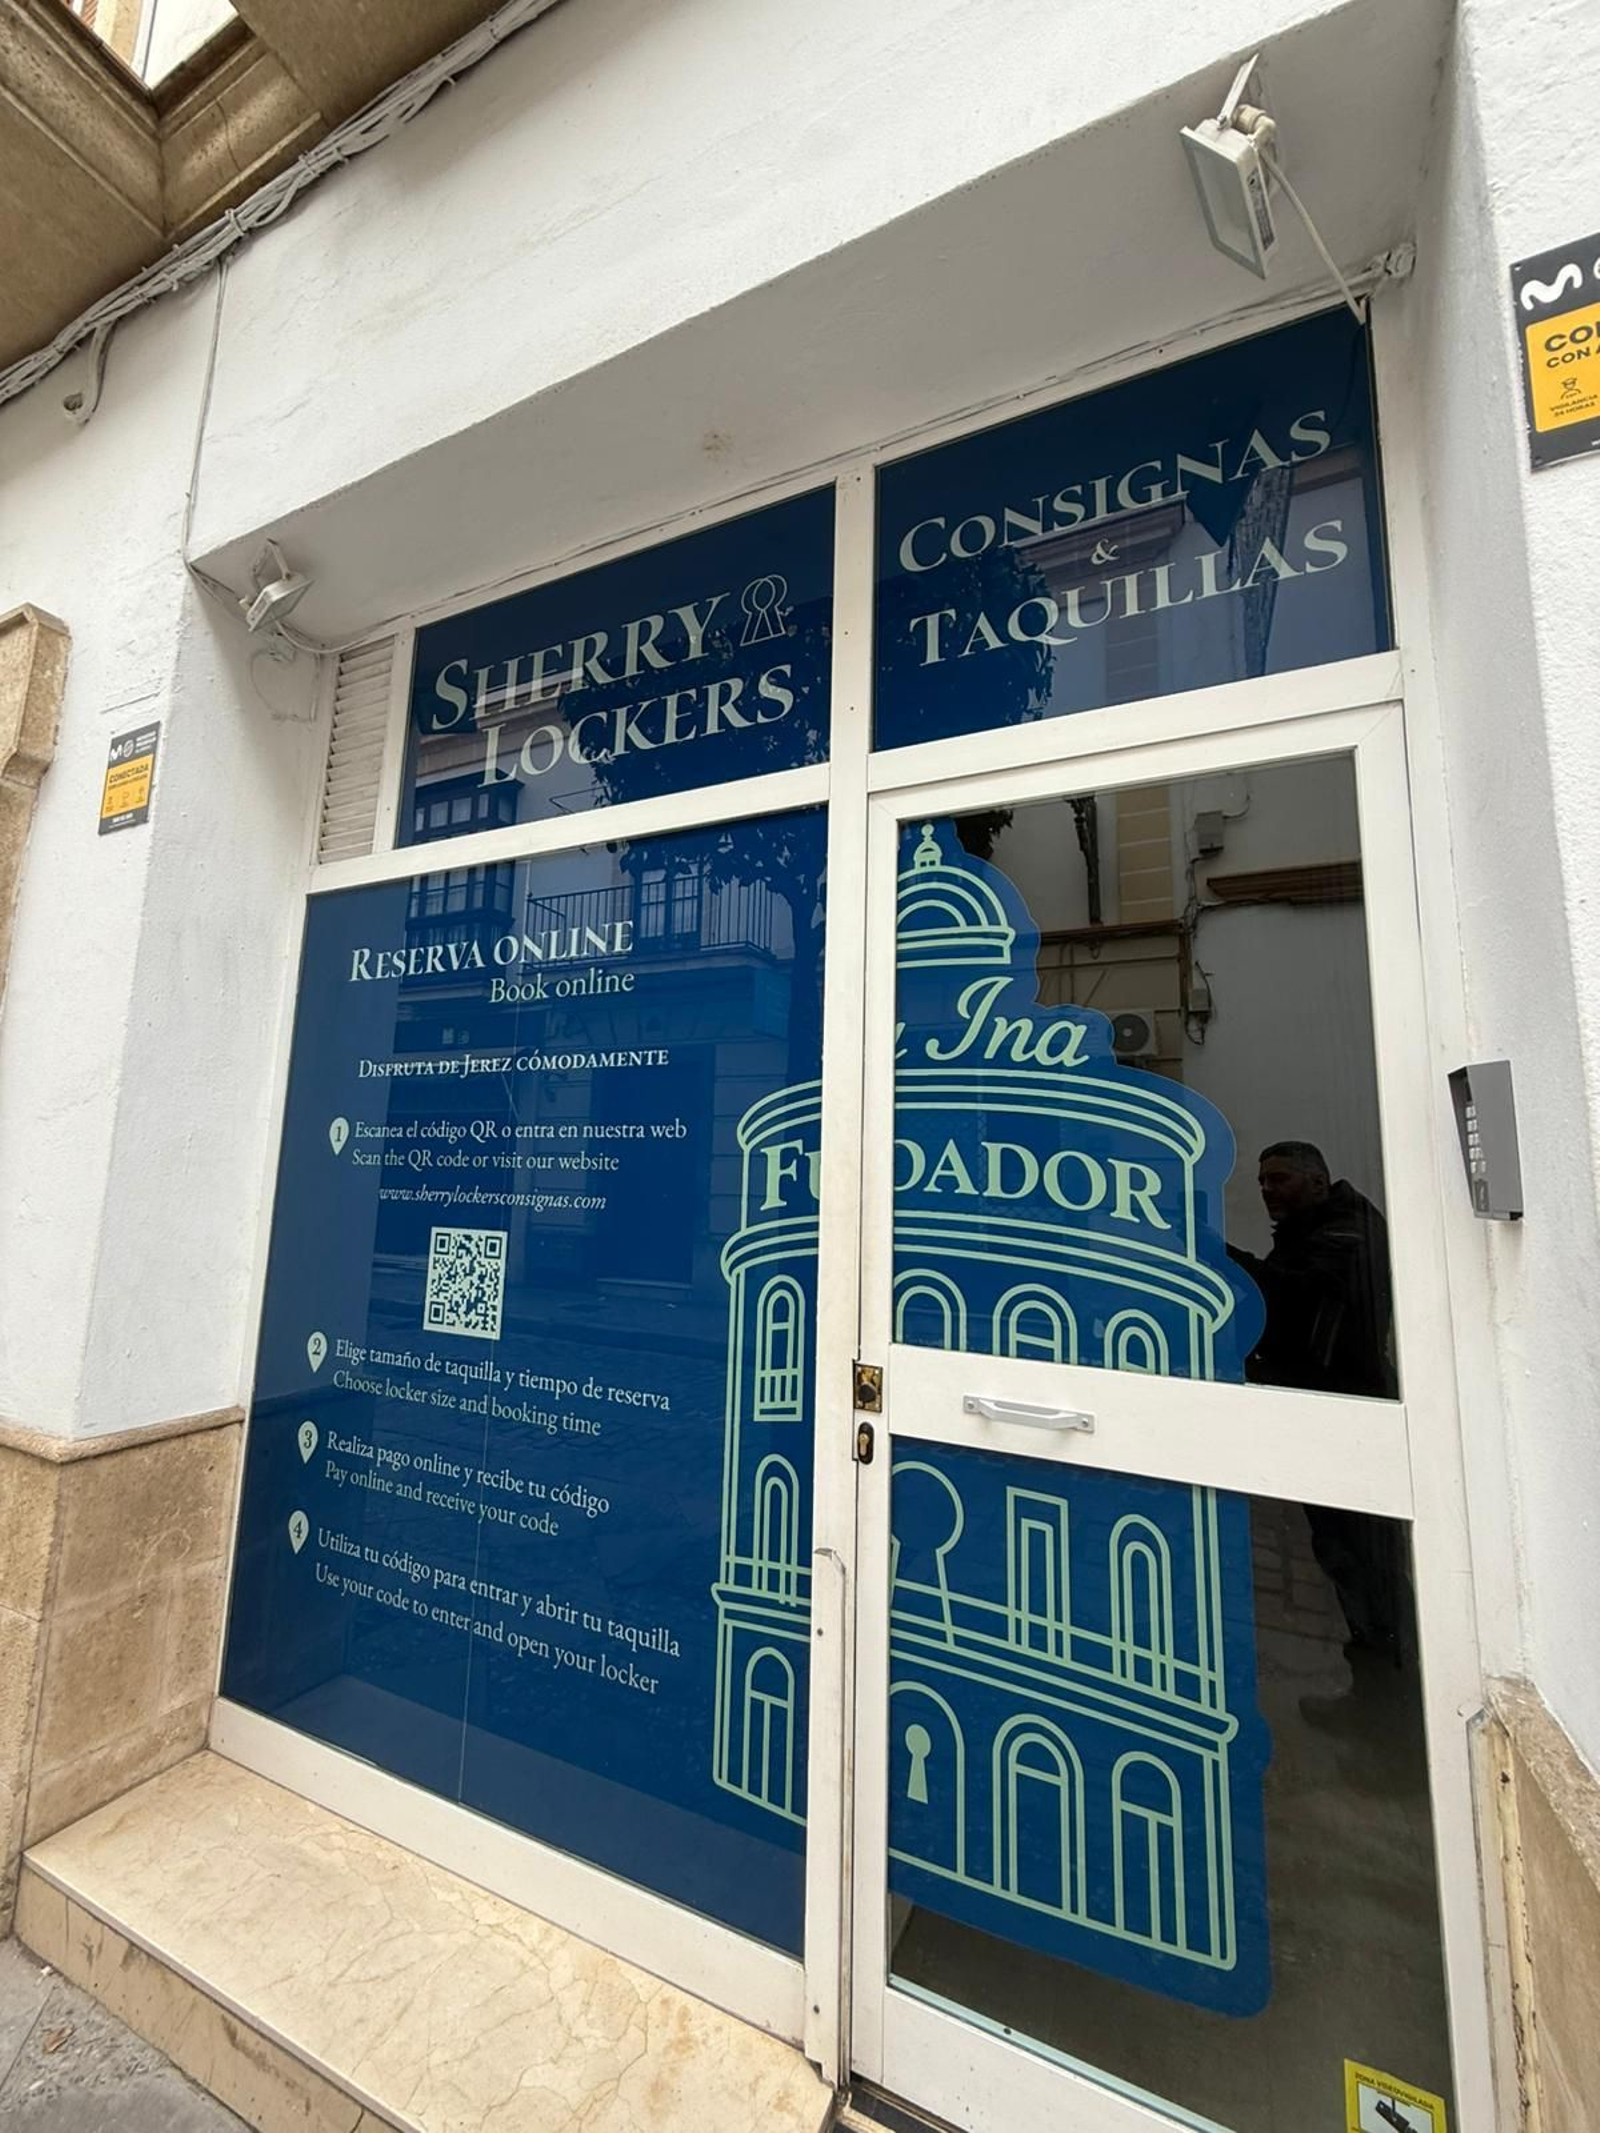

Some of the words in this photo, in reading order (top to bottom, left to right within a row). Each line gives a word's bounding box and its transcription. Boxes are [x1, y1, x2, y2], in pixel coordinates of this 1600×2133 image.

[1545, 321, 1600, 352] CO
[1547, 346, 1591, 368] CON
[899, 410, 1331, 572] CONSIGNAS
[1090, 538, 1119, 566] &
[909, 520, 1349, 667] TAQUILLAS
[431, 591, 730, 731] SHERRY
[477, 663, 794, 788] LOCKERS
[349, 939, 485, 981] RESERVA
[493, 920, 634, 965] ONLINE
[489, 978, 548, 1003] Book
[556, 967, 635, 997] online
[925, 976, 1089, 1067] Ina
[358, 1059, 435, 1078] DISFRUTA
[438, 1061, 460, 1075] DE
[460, 1053, 512, 1078] JEREZ
[516, 1049, 669, 1072] CÓMODAMENTE
[334, 1125, 343, 1142] 1
[354, 1121, 402, 1139] Escanea
[406, 1121, 417, 1138] el
[420, 1120, 466, 1144] código
[470, 1120, 498, 1143] QR
[501, 1126, 511, 1138] o
[515, 1124, 554, 1138] entra
[559, 1125, 578, 1138] en
[583, 1122, 644, 1138] nuestra
[651, 1119, 687, 1138] web
[352, 1148, 380, 1166] Scan
[384, 1149, 404, 1166] the
[408, 1151, 433, 1171] QR
[436, 1152, 469, 1168] code
[473, 1155, 489, 1168] or
[492, 1152, 522, 1169] visit
[526, 1156, 554, 1170] our
[559, 1153, 619, 1171] website
[379, 1185, 606, 1211] www.sherrylockersconsignas.com
[759, 1138, 1172, 1230] FDADOR
[312, 1338, 321, 1355] 2
[335, 1339, 367, 1366] Elige
[370, 1351, 421, 1370] tamaño
[425, 1351, 442, 1373] de
[446, 1358, 501, 1385] taquilla
[503, 1370, 515, 1390] y
[519, 1371, 578, 1401] tiempo
[582, 1377, 602, 1399] de
[608, 1387, 670, 1411] reserva
[333, 1370, 382, 1396] Choose
[386, 1378, 428, 1404] locker
[430, 1387, 456, 1408] size
[459, 1394, 488, 1415] and
[491, 1396, 558, 1434] booking
[562, 1415, 601, 1436] time
[304, 1430, 312, 1449] 3
[328, 1431, 374, 1459] Realiza
[377, 1448, 410, 1471] pago
[413, 1452, 461, 1478] online
[464, 1466, 473, 1486] y
[477, 1468, 524, 1494] recibe
[528, 1479, 546, 1498] tu
[551, 1483, 609, 1518] código
[325, 1460, 349, 1488] Pay
[350, 1469, 393, 1494] online
[396, 1480, 422, 1501] and
[426, 1488, 476, 1515] receive
[478, 1500, 516, 1526] your
[519, 1508, 559, 1536] code
[294, 1520, 302, 1538] 4
[318, 1528, 361, 1558] Utiliza
[364, 1547, 378, 1564] tu
[382, 1550, 430, 1583] código
[434, 1566, 466, 1590] para
[470, 1578, 518, 1607] entrar
[522, 1592, 532, 1616] y
[536, 1596, 578, 1625] abrir
[582, 1611, 601, 1633] tu
[607, 1616, 680, 1657] taquilla
[315, 1563, 340, 1587] Use
[341, 1575, 373, 1598] your
[376, 1584, 409, 1611] code
[413, 1599, 428, 1617] to
[431, 1605, 471, 1630] enter
[473, 1618, 502, 1643] and
[508, 1629, 549, 1659] open
[553, 1642, 596, 1674] your
[601, 1654, 659, 1694] locker
